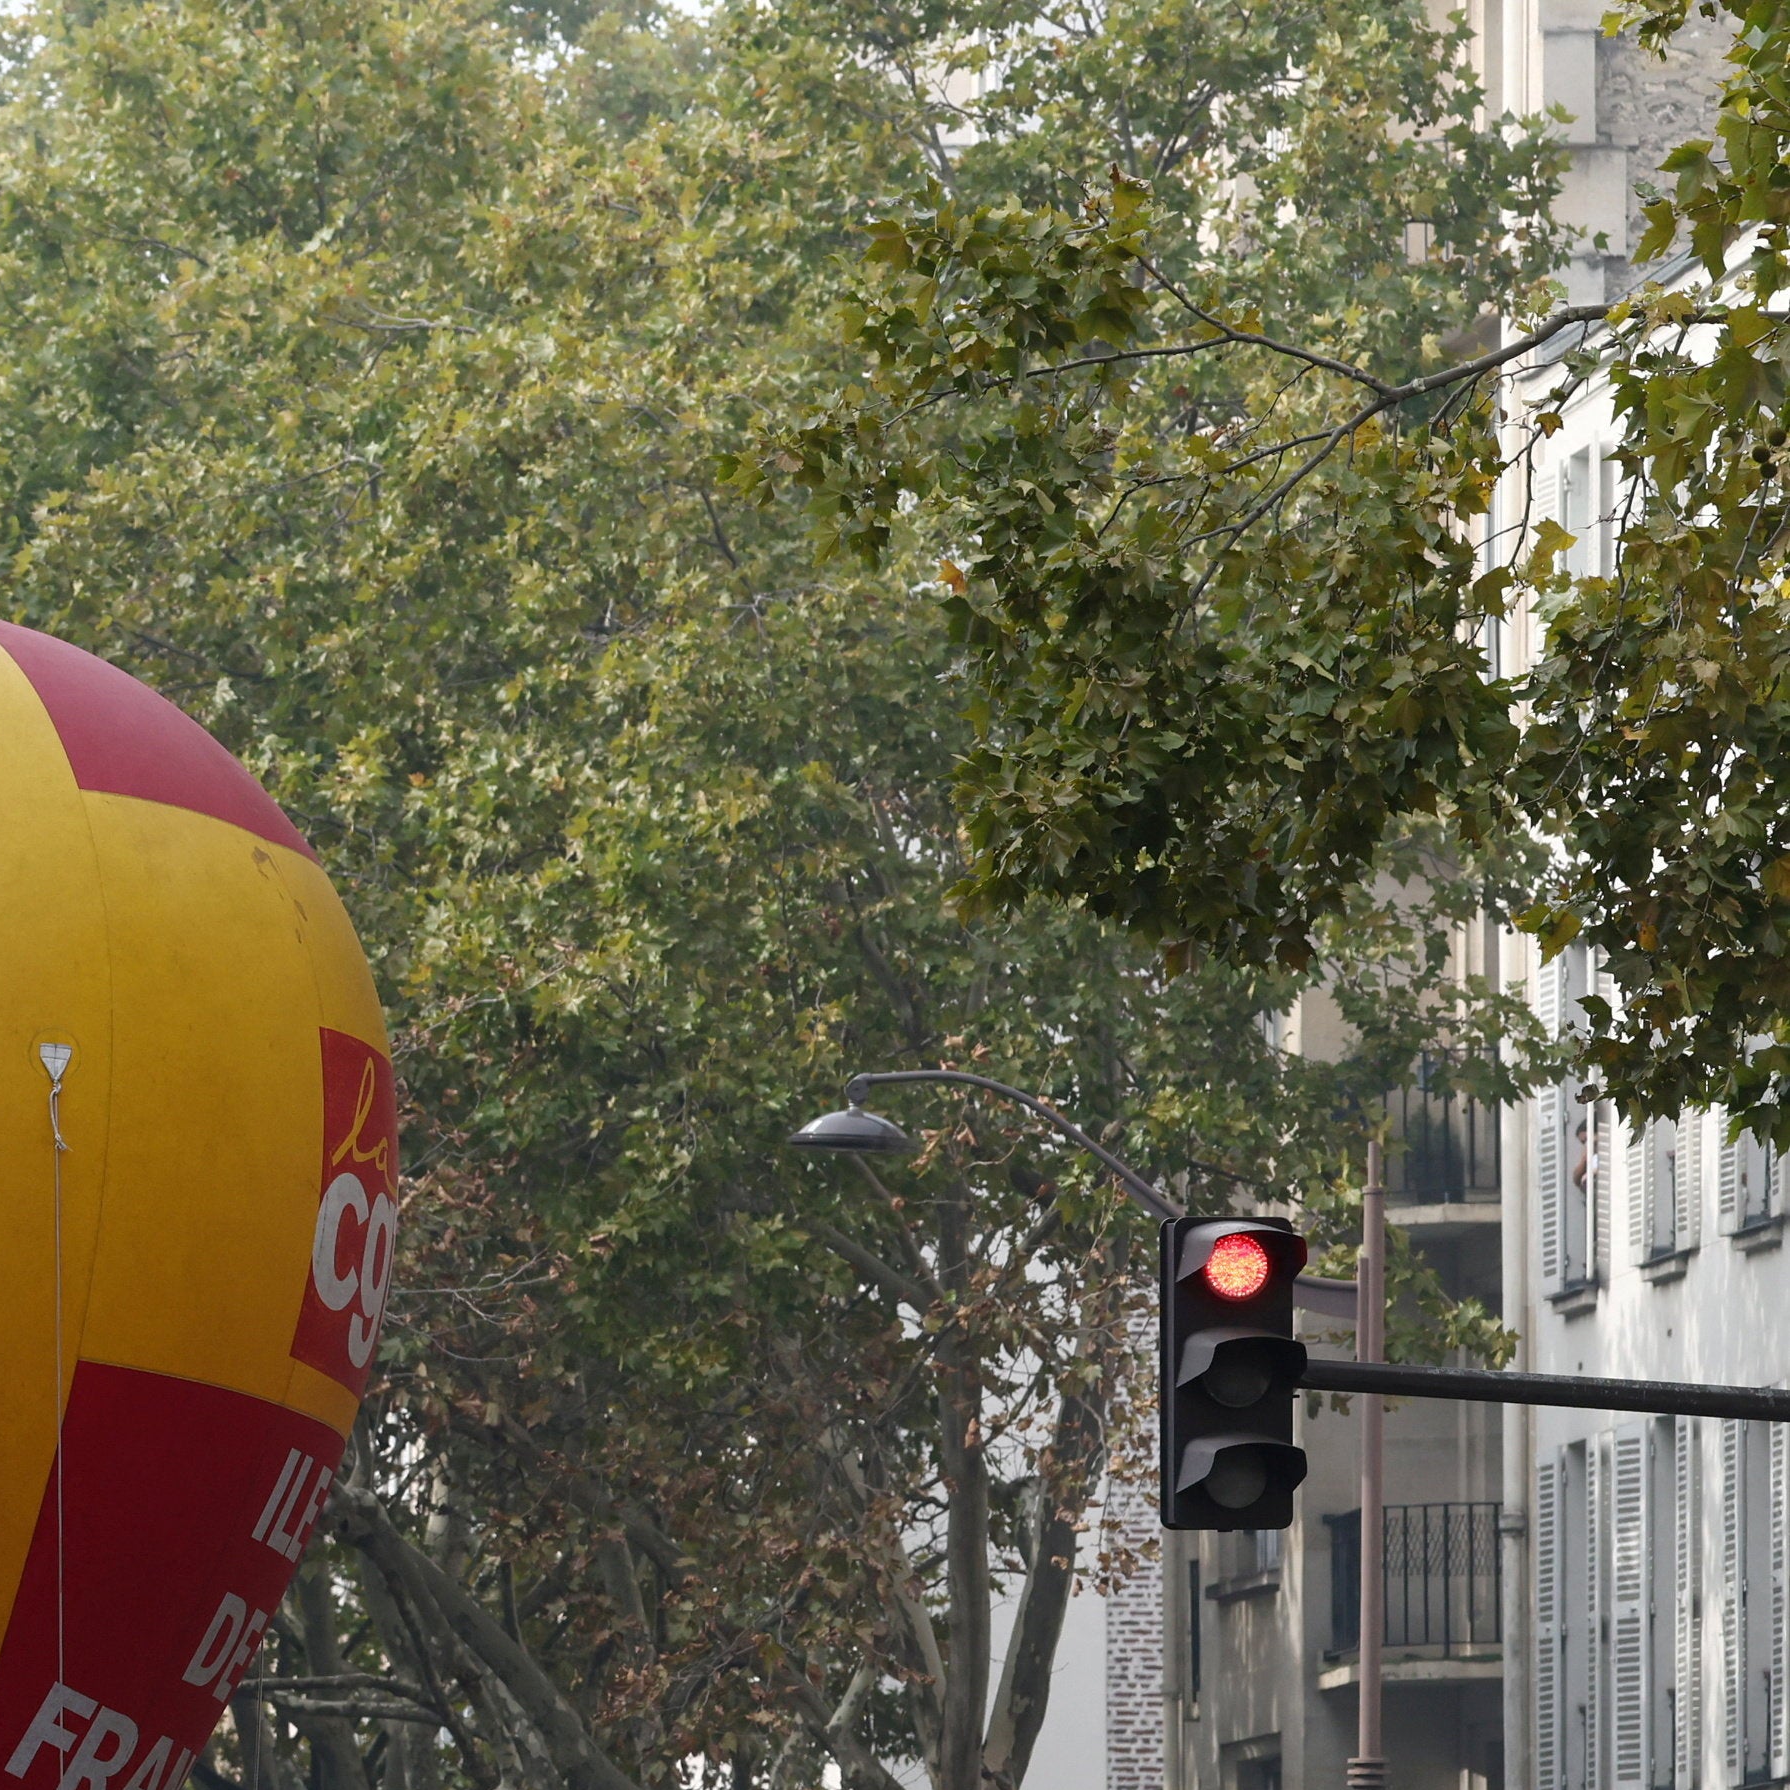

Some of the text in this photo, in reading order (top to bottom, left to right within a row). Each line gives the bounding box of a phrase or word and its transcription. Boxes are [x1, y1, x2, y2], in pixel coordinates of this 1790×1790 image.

[312, 1172, 397, 1370] cg
[251, 1447, 331, 1565] ILE
[182, 1590, 269, 1705] DE
